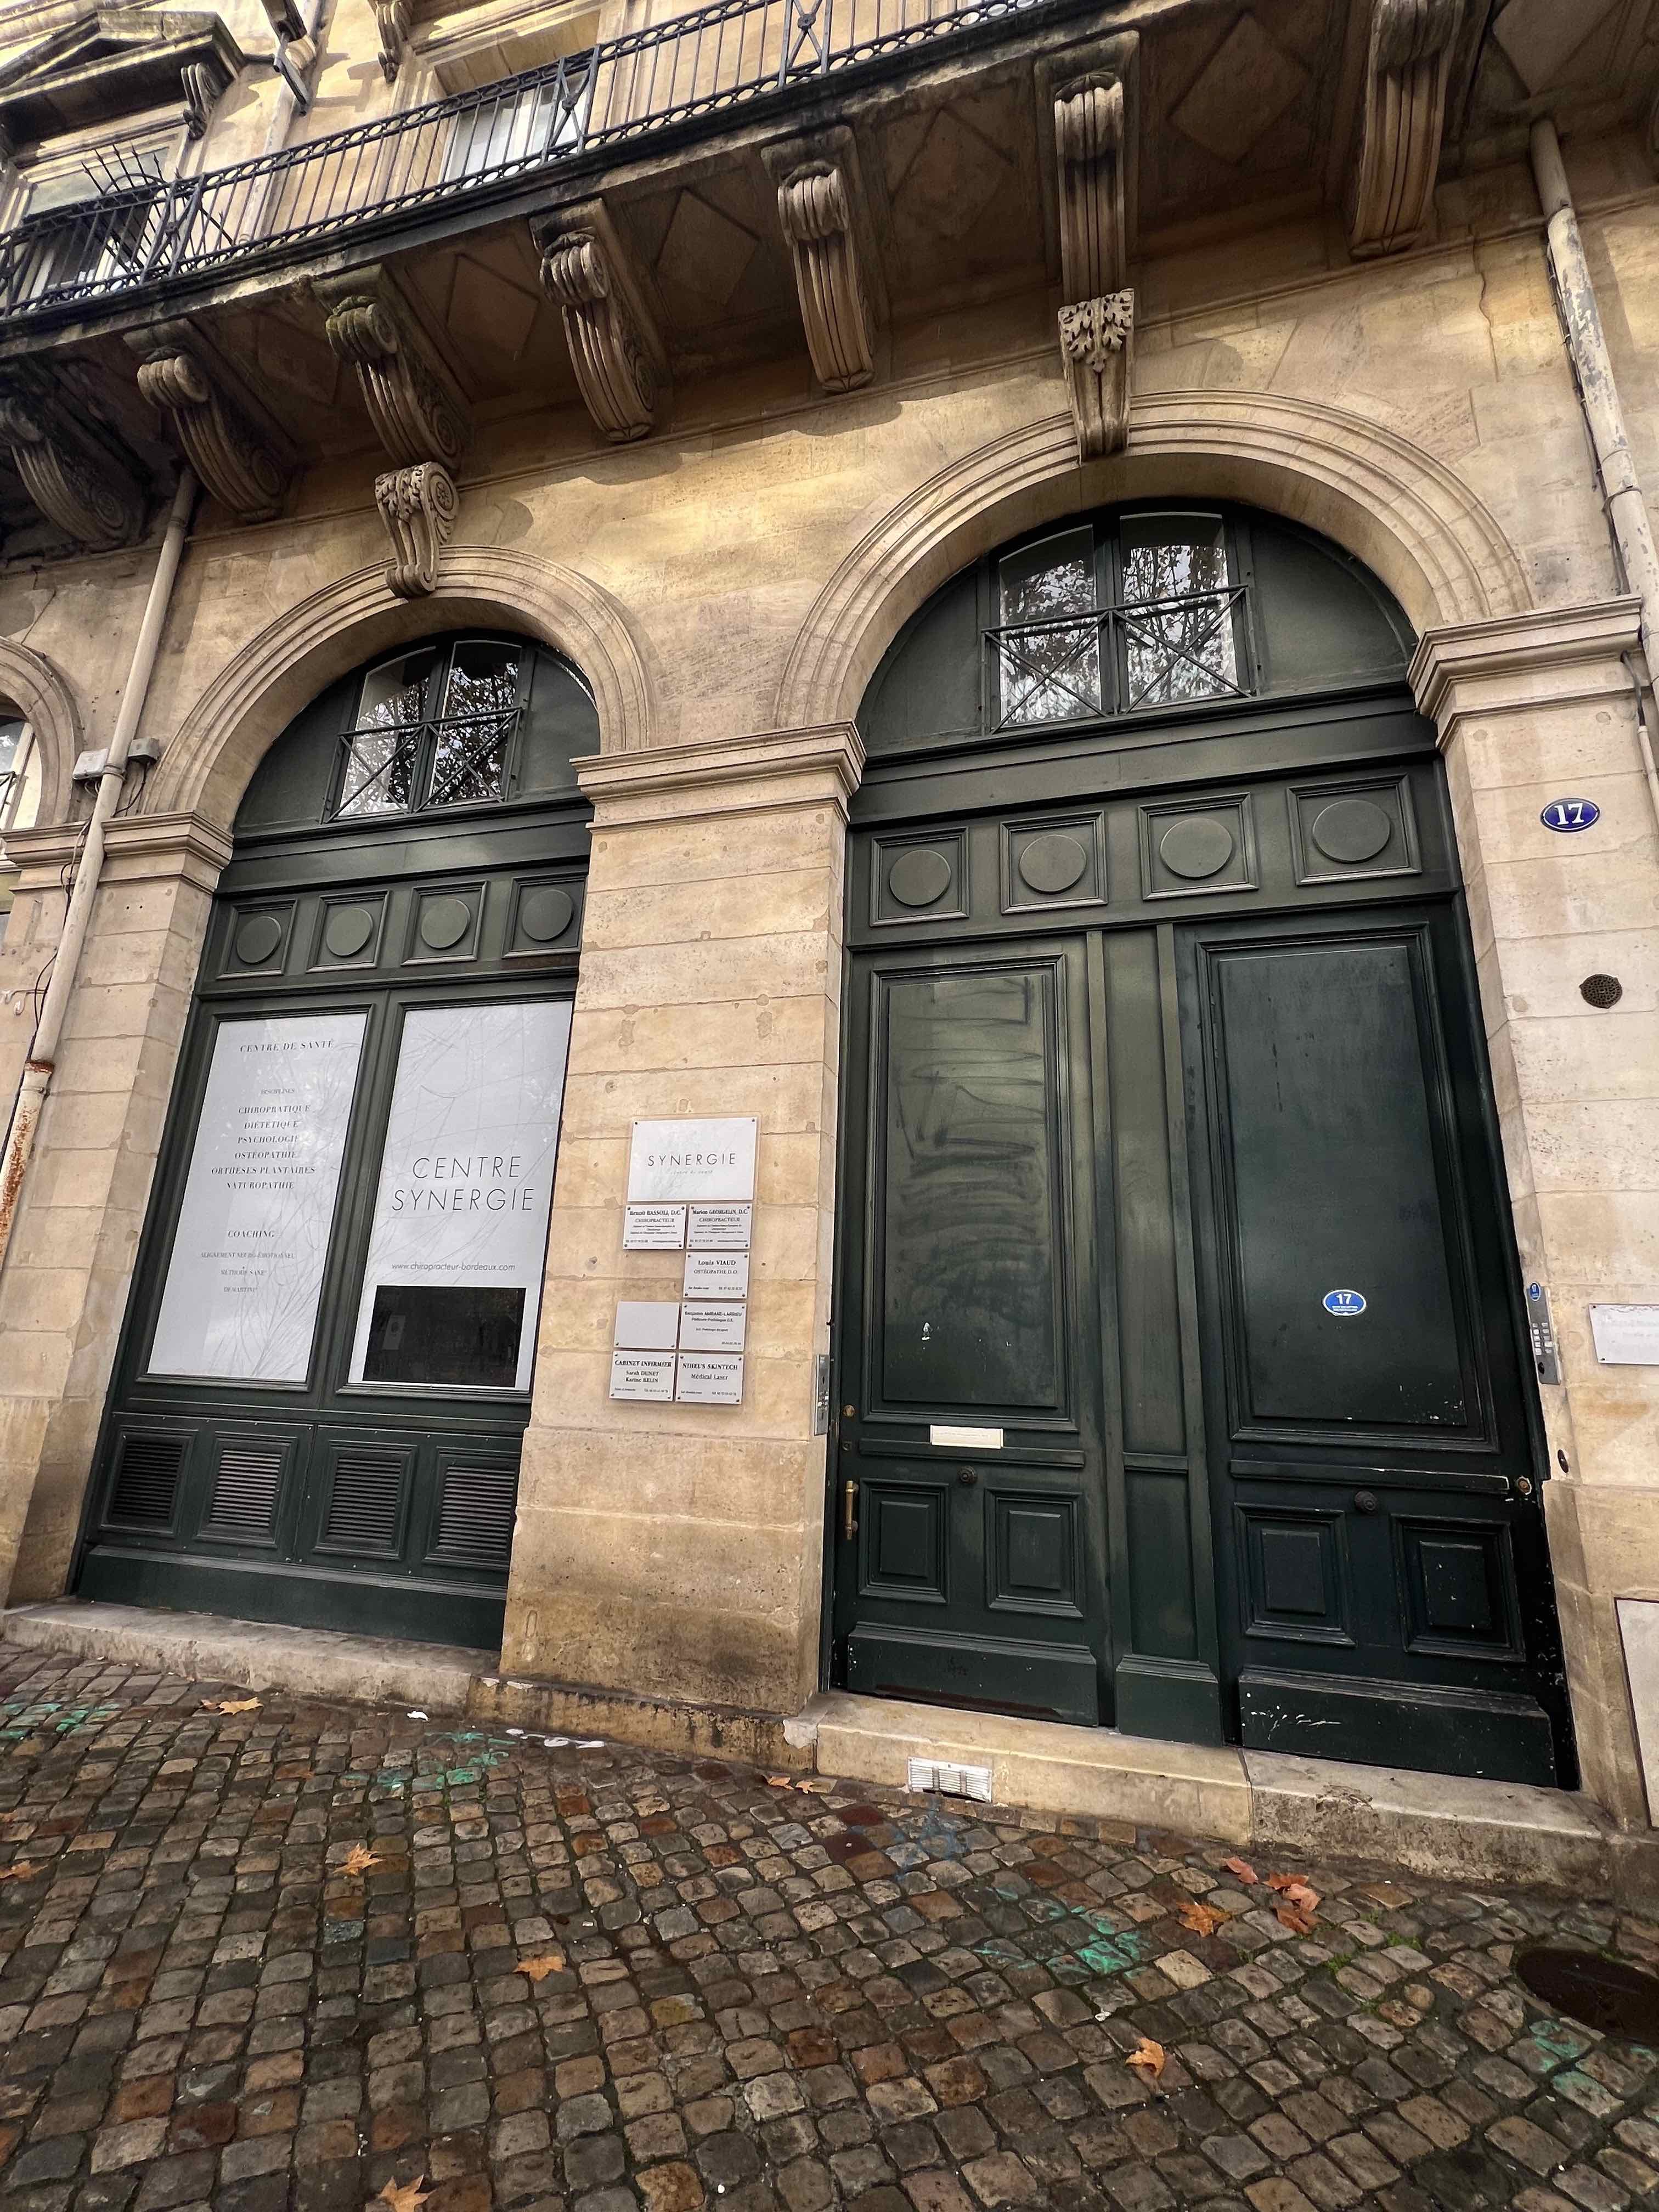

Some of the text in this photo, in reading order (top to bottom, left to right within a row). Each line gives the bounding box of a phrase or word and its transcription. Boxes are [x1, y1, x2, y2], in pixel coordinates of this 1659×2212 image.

[1554, 803, 1584, 825] 17
[240, 1039, 334, 1052] CENTRE DE SANTÉ
[647, 1153, 736, 1167] SYNERGIE
[412, 1156, 522, 1178] CENTRE
[227, 1181, 295, 1189] NATUROPATHIE
[392, 1188, 535, 1211] SYNERGIE
[392, 1261, 516, 1272] www.chiropracteur-bordeaux.com
[1336, 1294, 1352, 1305] 17
